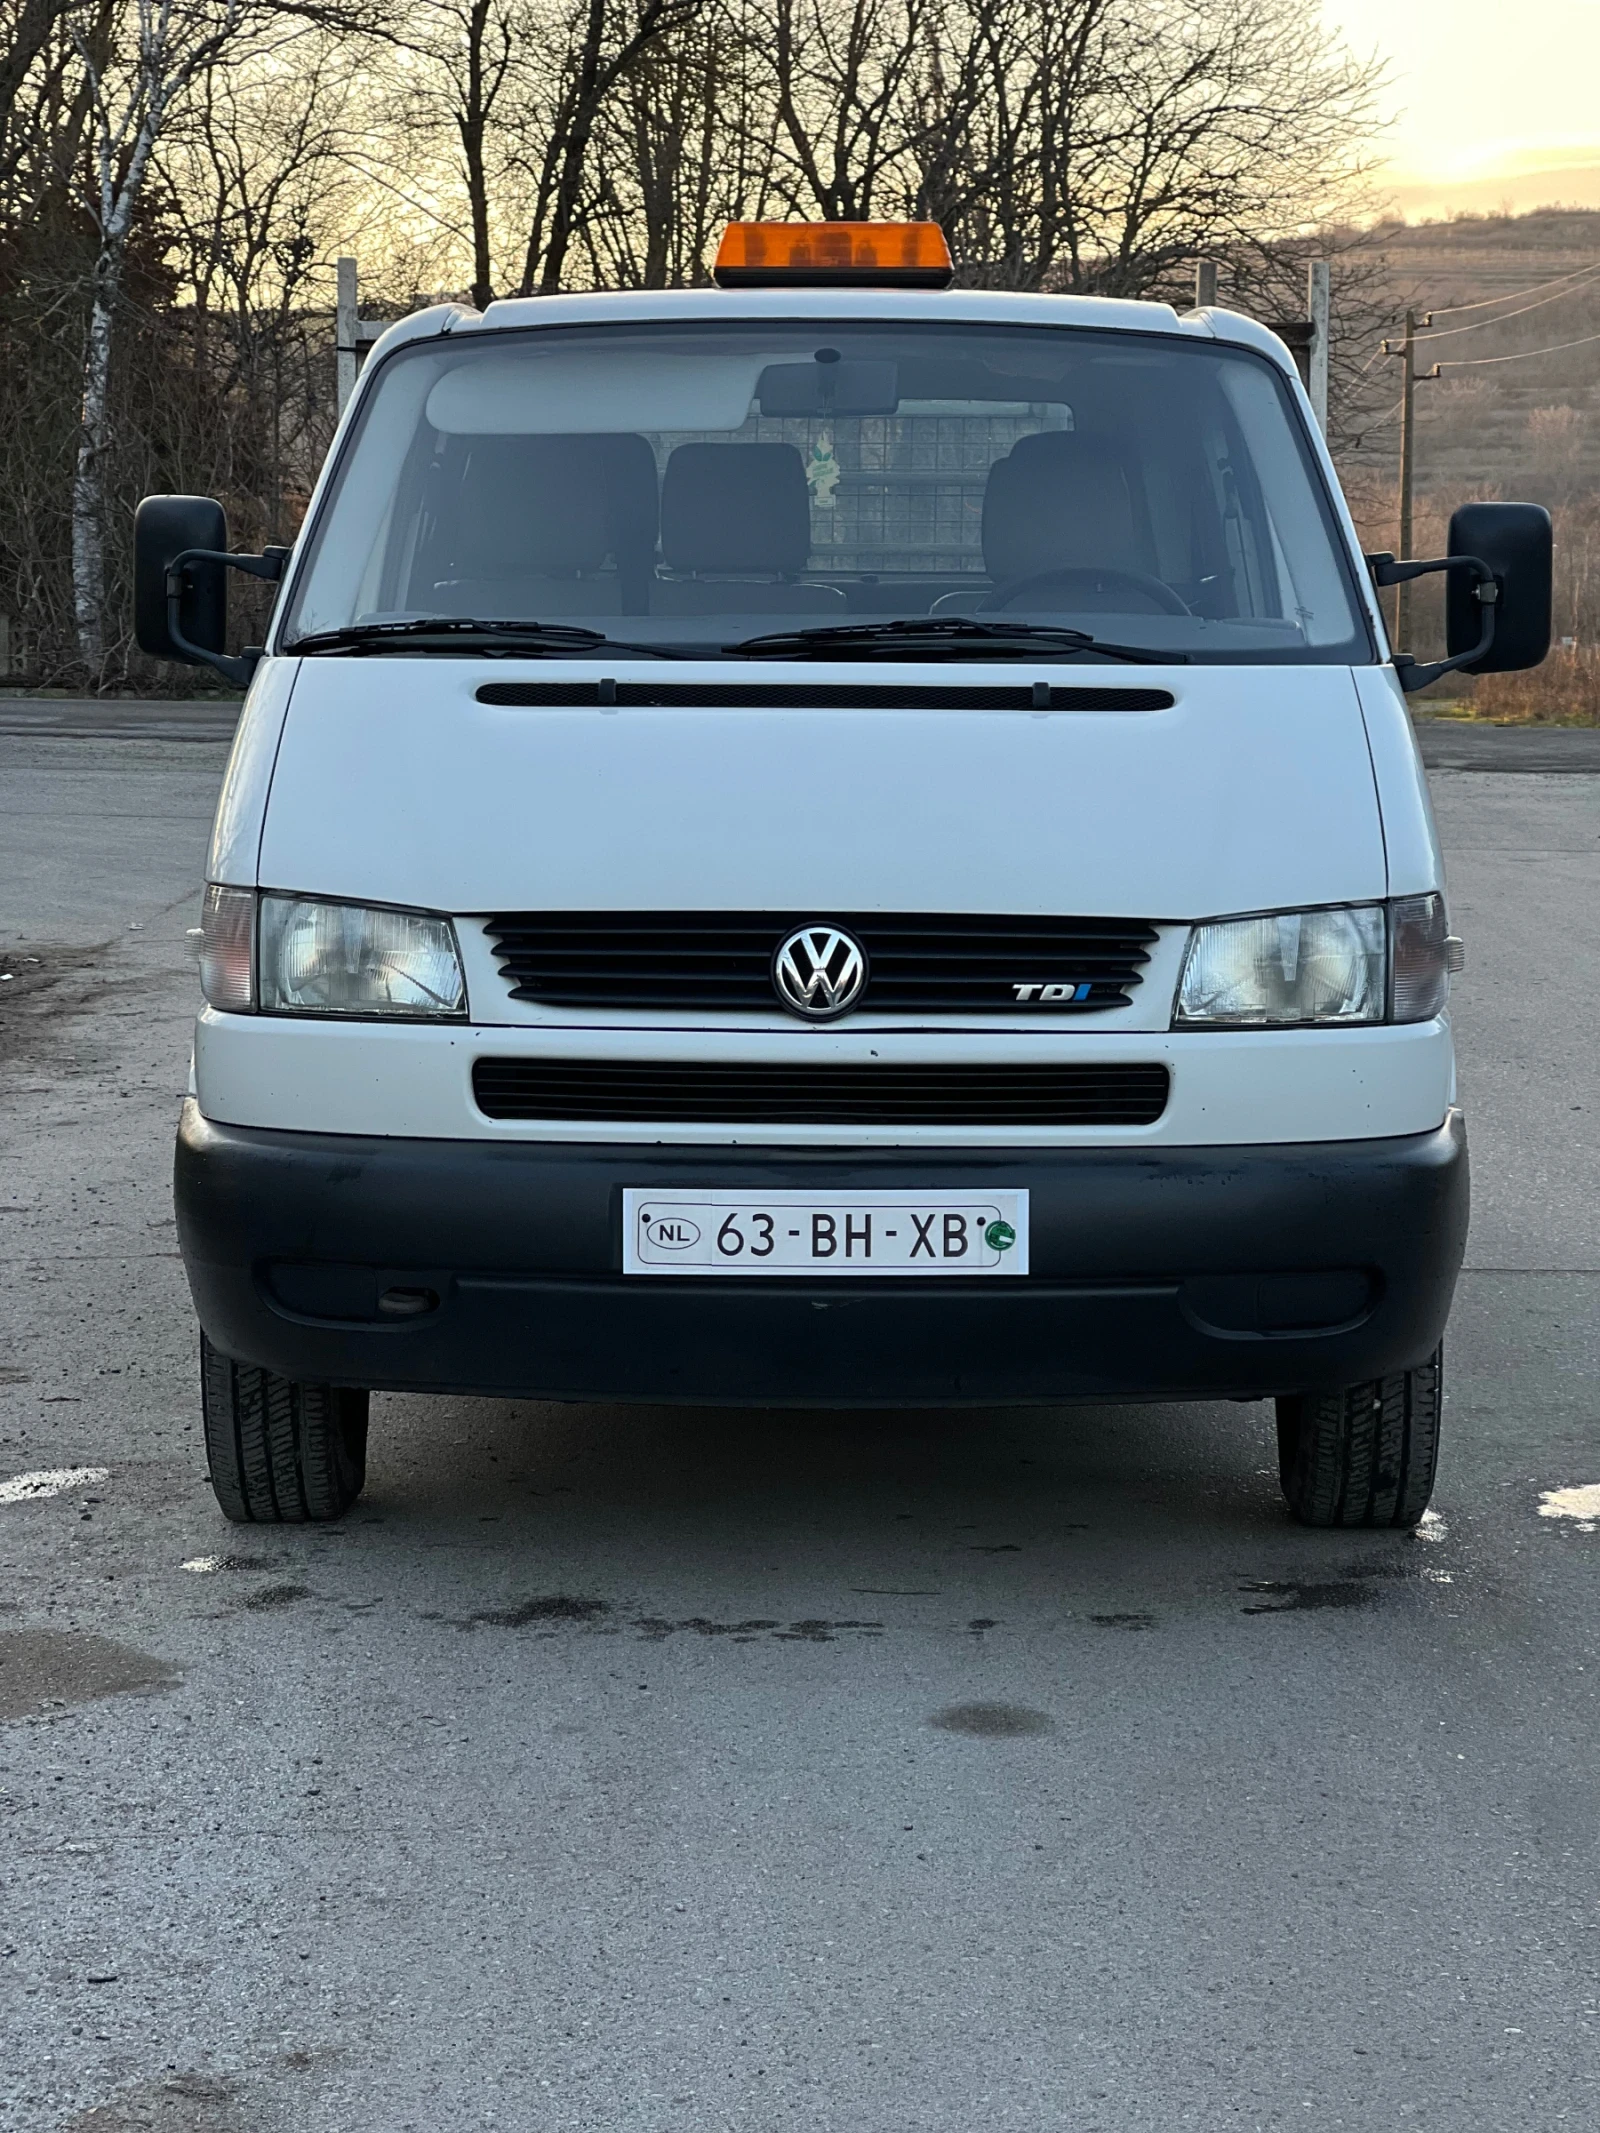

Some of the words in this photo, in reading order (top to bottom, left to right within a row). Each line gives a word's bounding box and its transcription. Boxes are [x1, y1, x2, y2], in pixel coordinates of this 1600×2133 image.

[776, 926, 864, 1012] VW
[1012, 983, 1092, 1001] TDI
[658, 1225, 690, 1242] NL
[716, 1212, 969, 1258] 63-BH-XB
